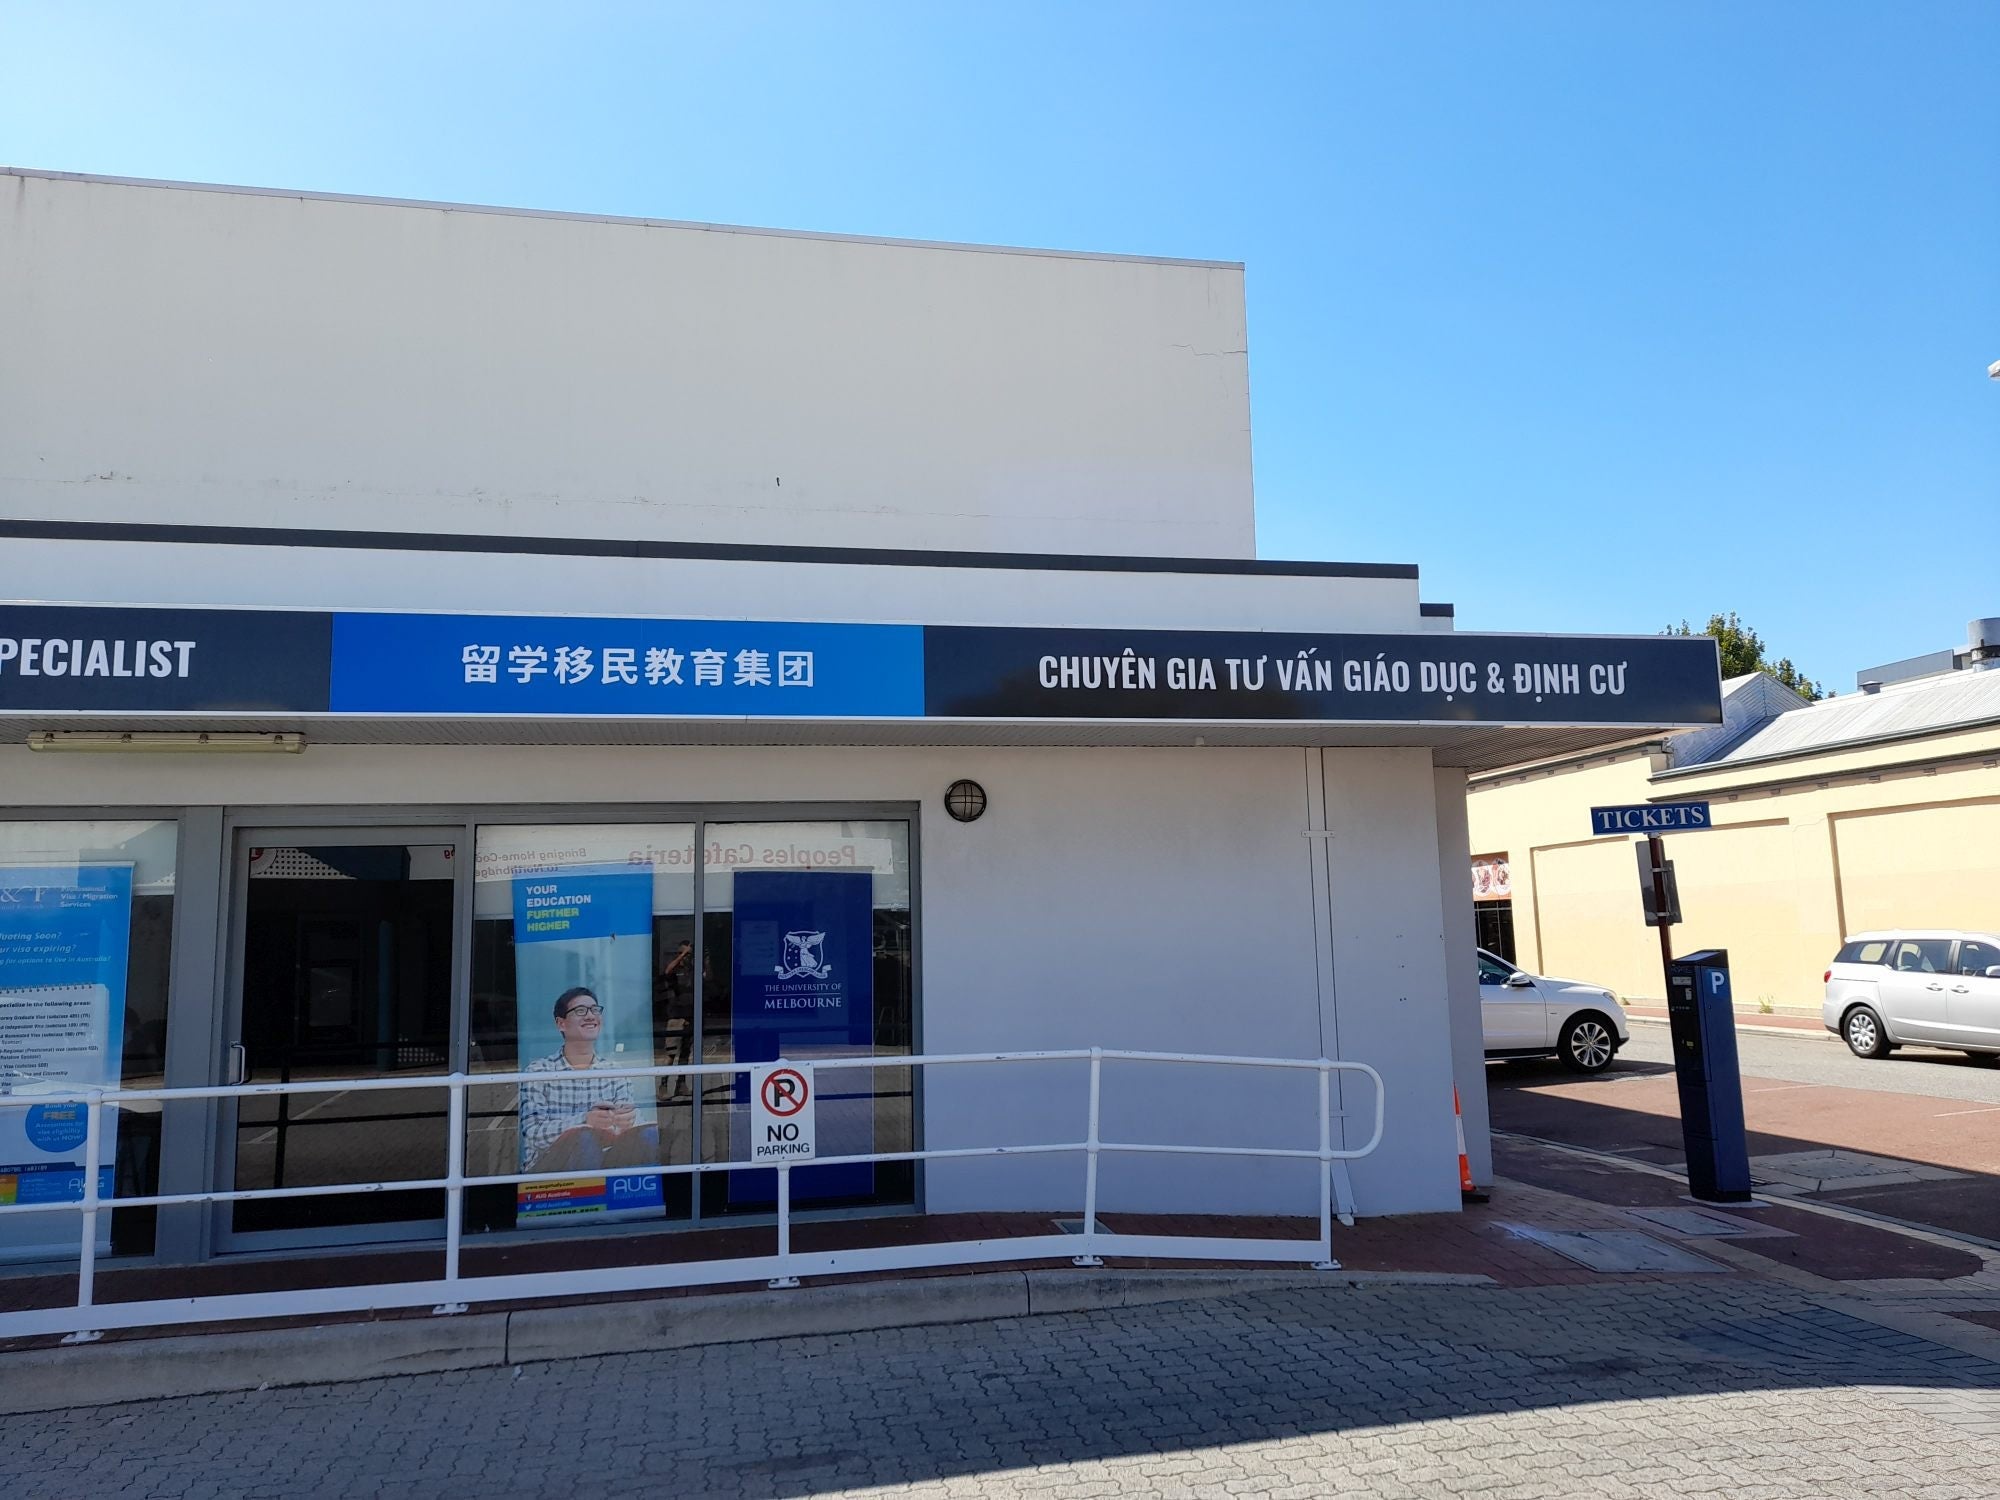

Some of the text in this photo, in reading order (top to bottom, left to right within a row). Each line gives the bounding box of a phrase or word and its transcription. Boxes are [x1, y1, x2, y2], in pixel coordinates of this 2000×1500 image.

[0, 638, 196, 680] PECIALIST
[462, 644, 814, 688] 留学移民教育集团
[1039, 647, 1627, 703] CHUYÊN GIA TƯ VẤN GIÁO DỤC & ĐỊNH CƯ
[1598, 806, 1705, 829] TICKETS
[526, 884, 558, 896] YOUR
[82, 893, 119, 901] Migration
[527, 895, 592, 908] EDUCATION
[527, 907, 580, 921] FURTHER
[527, 920, 570, 933] HIGHER
[34, 931, 62, 940] Soon?
[13, 945, 32, 953] visa
[33, 944, 78, 954] expiring?
[764, 982, 842, 992] THE UNIVERSITY OF
[1711, 971, 1725, 994] P
[764, 997, 842, 1009] MELBOURNE
[43, 1111, 77, 1120] FREE
[767, 1123, 800, 1143] NO
[757, 1143, 810, 1157] PARKING
[613, 1175, 657, 1194] AUG
